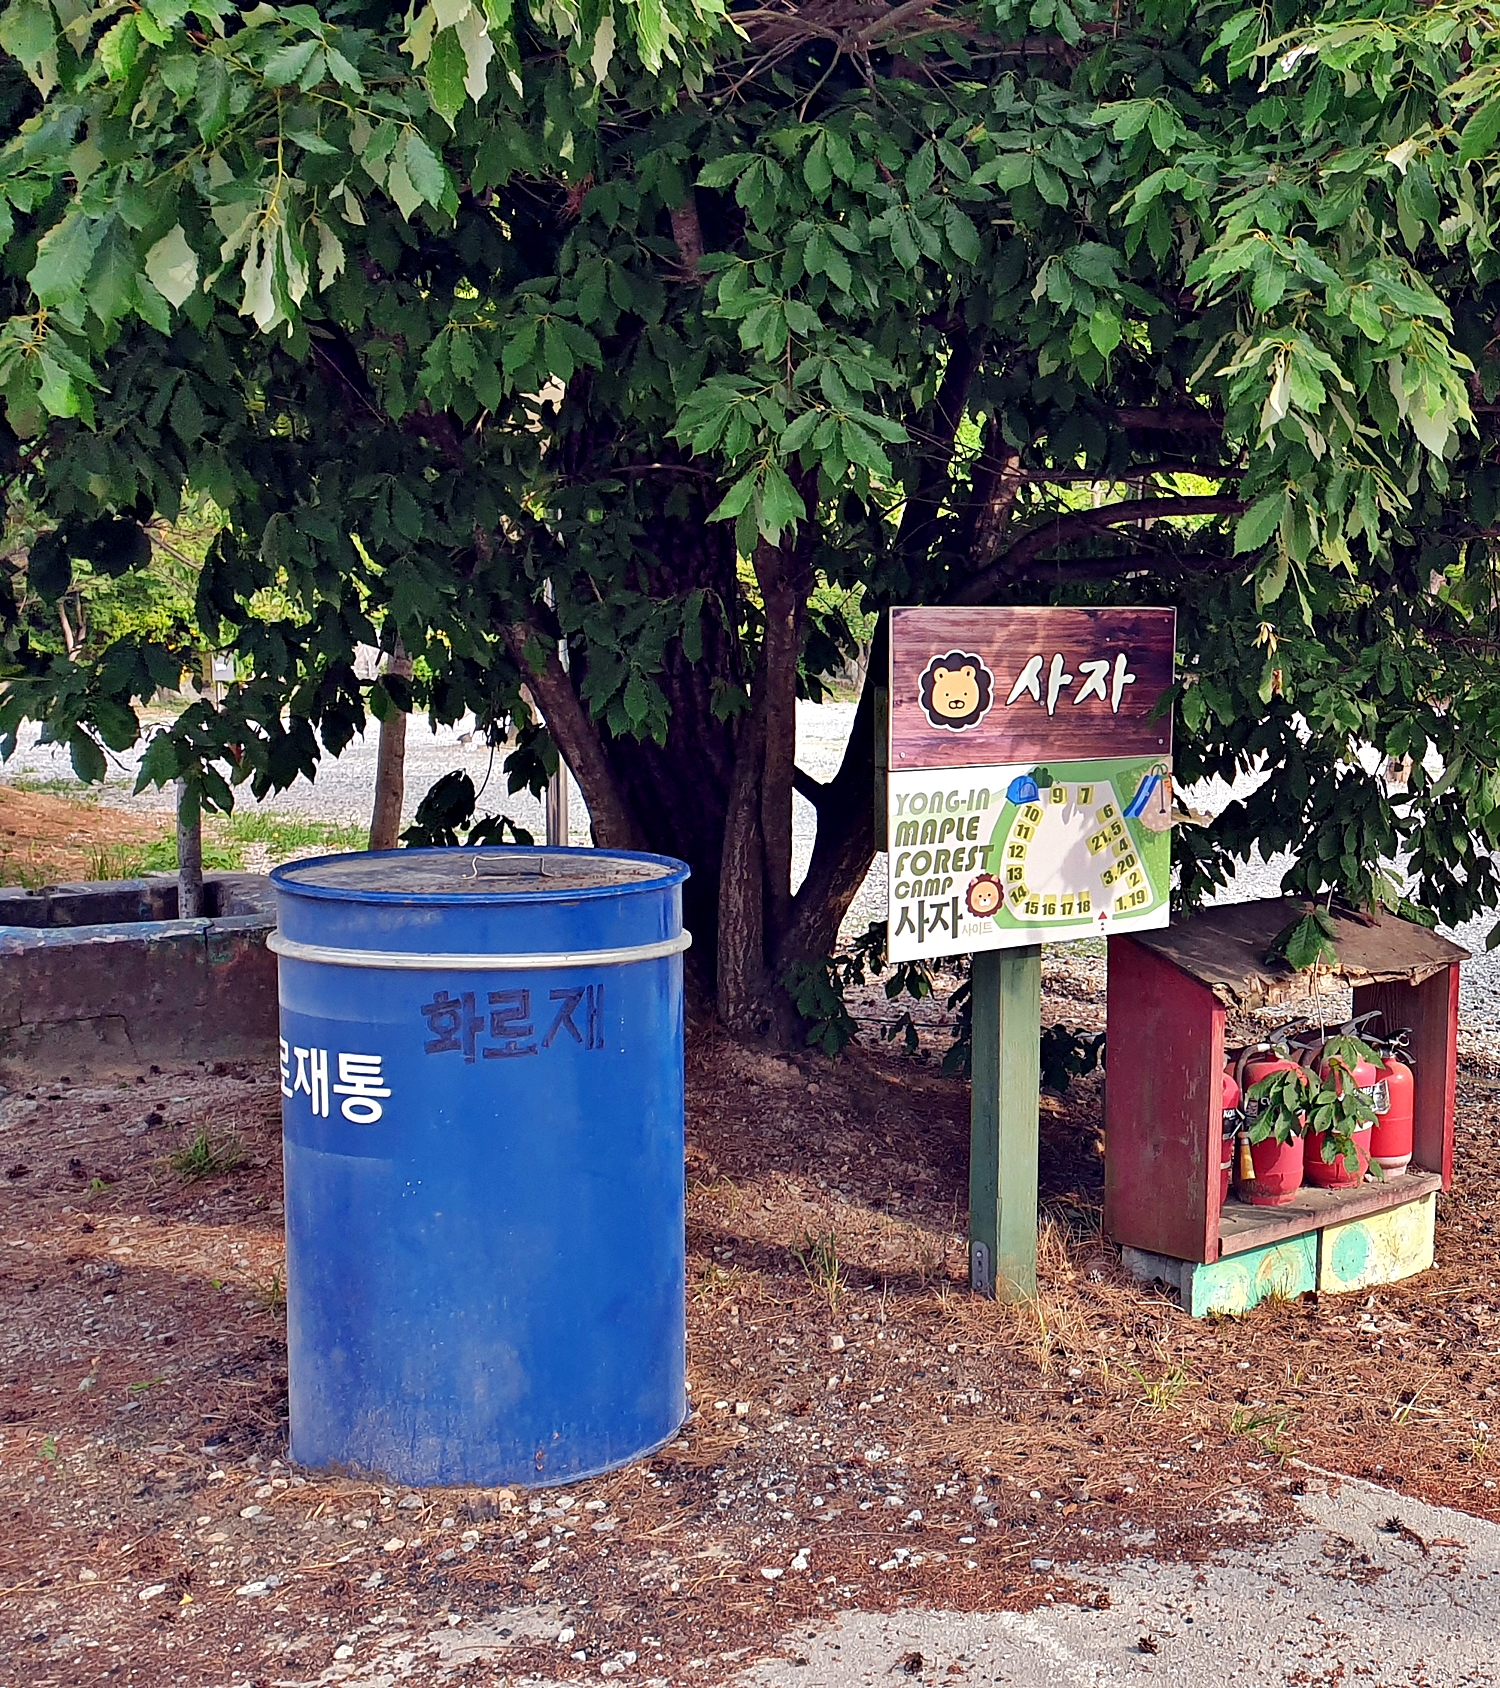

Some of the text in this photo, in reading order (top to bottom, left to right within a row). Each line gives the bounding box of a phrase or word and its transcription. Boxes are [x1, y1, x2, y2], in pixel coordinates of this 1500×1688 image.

[1005, 652, 1136, 716] 사자
[895, 788, 991, 816] YONG-IN
[1052, 787, 1063, 803] 9
[1081, 787, 1090, 803] 7
[1024, 805, 1039, 822] 10
[1103, 804, 1114, 818] 6
[894, 816, 980, 847] MAPLE
[1017, 824, 1030, 839] 11
[1009, 845, 1024, 858] 12
[1119, 838, 1128, 852] 4
[894, 845, 994, 878] FOREST
[1007, 867, 1022, 880] 13
[1129, 872, 1140, 886] 2
[894, 877, 953, 899] CAMP
[1010, 886, 1027, 903] 14
[1024, 901, 1038, 914] 15
[1042, 903, 1055, 915] 16
[1060, 902, 1073, 915] 17
[1077, 900, 1090, 913] 18
[894, 896, 963, 943] 사자
[962, 921, 993, 937] 사이트
